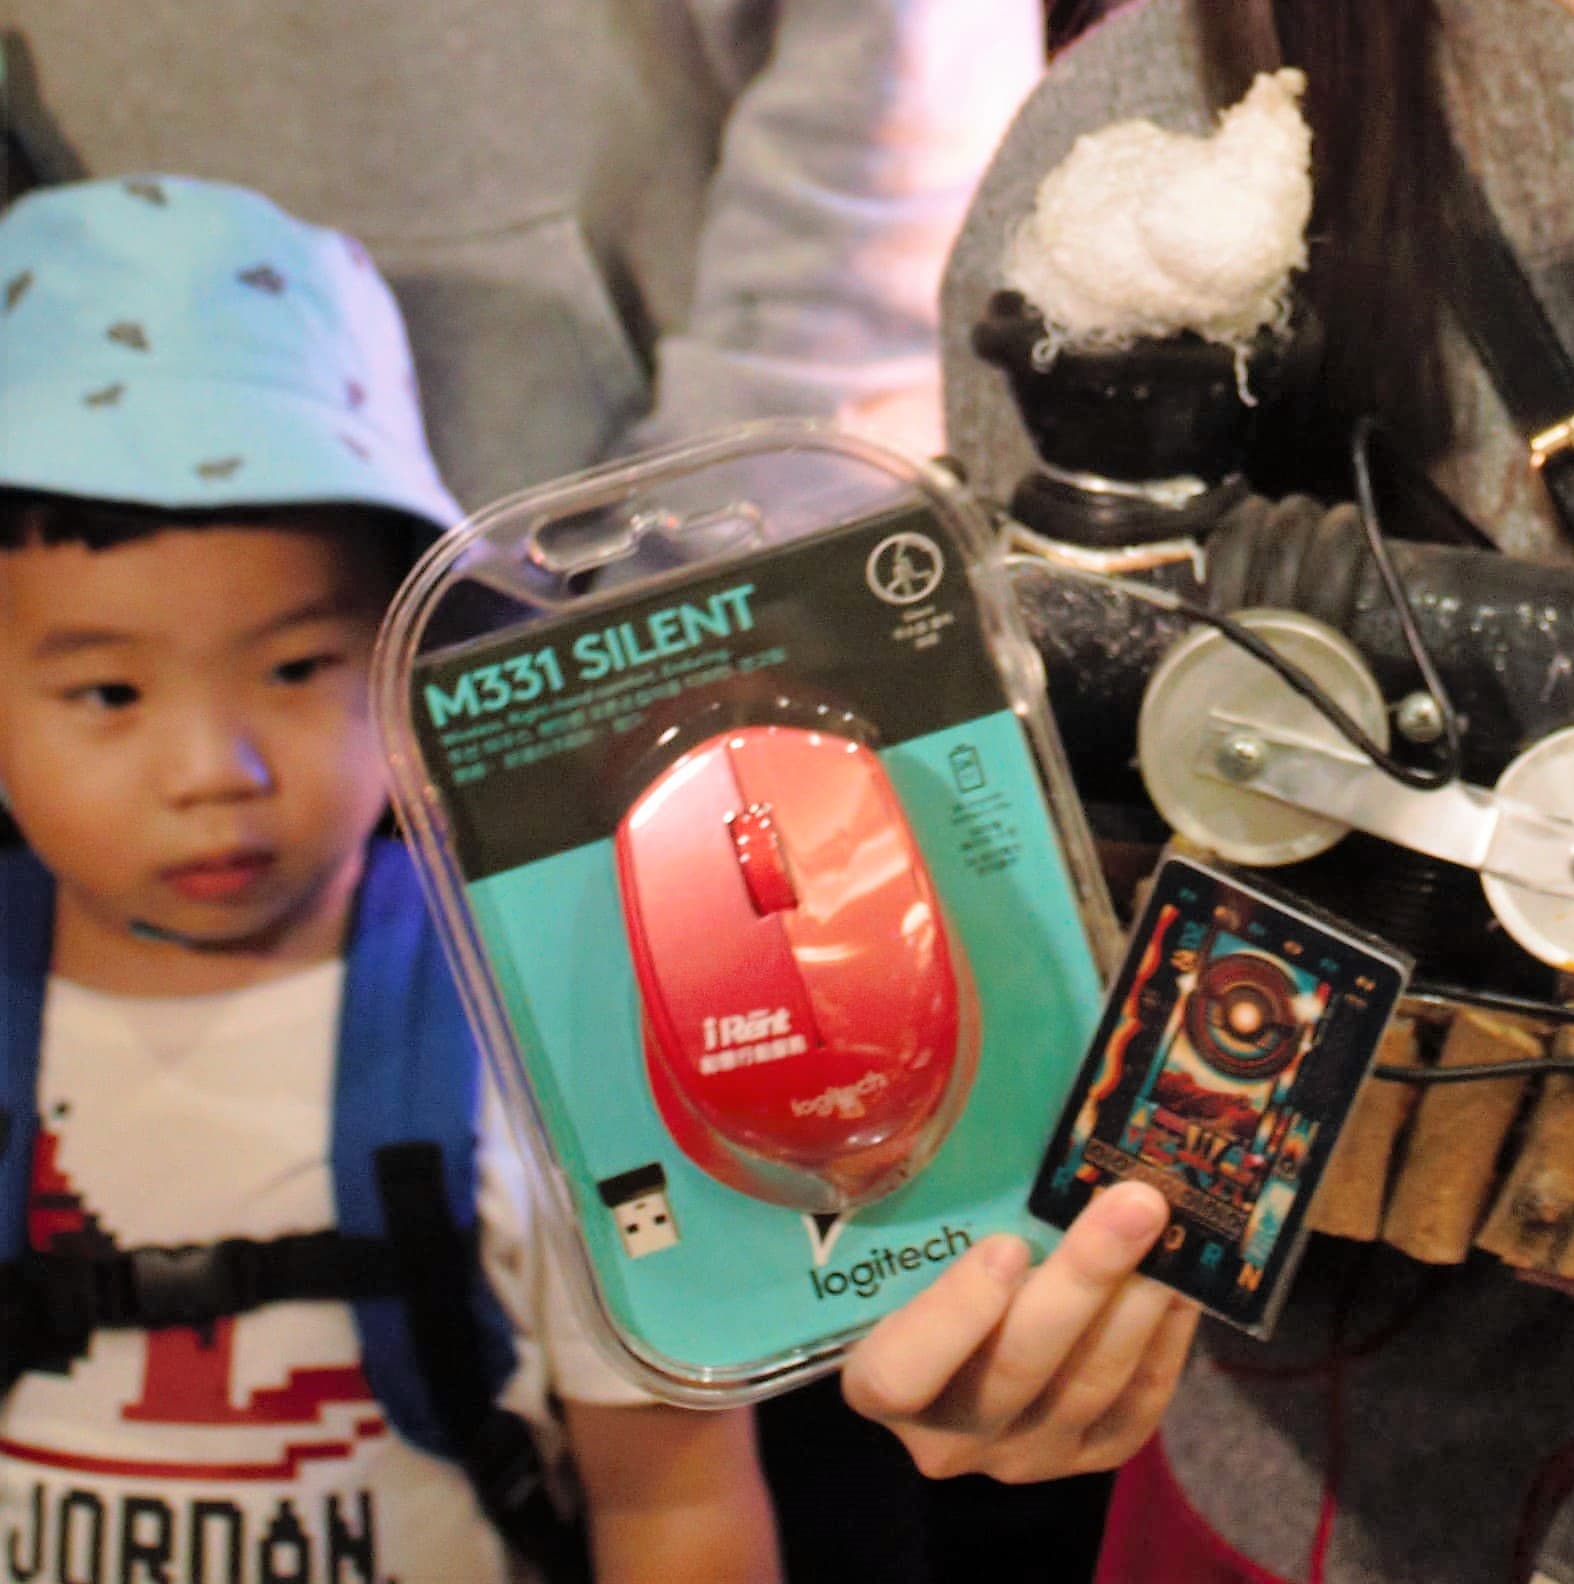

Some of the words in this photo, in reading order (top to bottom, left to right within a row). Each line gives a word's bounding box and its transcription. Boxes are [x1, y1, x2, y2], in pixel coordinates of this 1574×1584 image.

[424, 646, 565, 728] M331
[573, 583, 756, 681] SILENT
[809, 1225, 972, 1301] logitech
[8, 1479, 381, 1584] JORDAN
